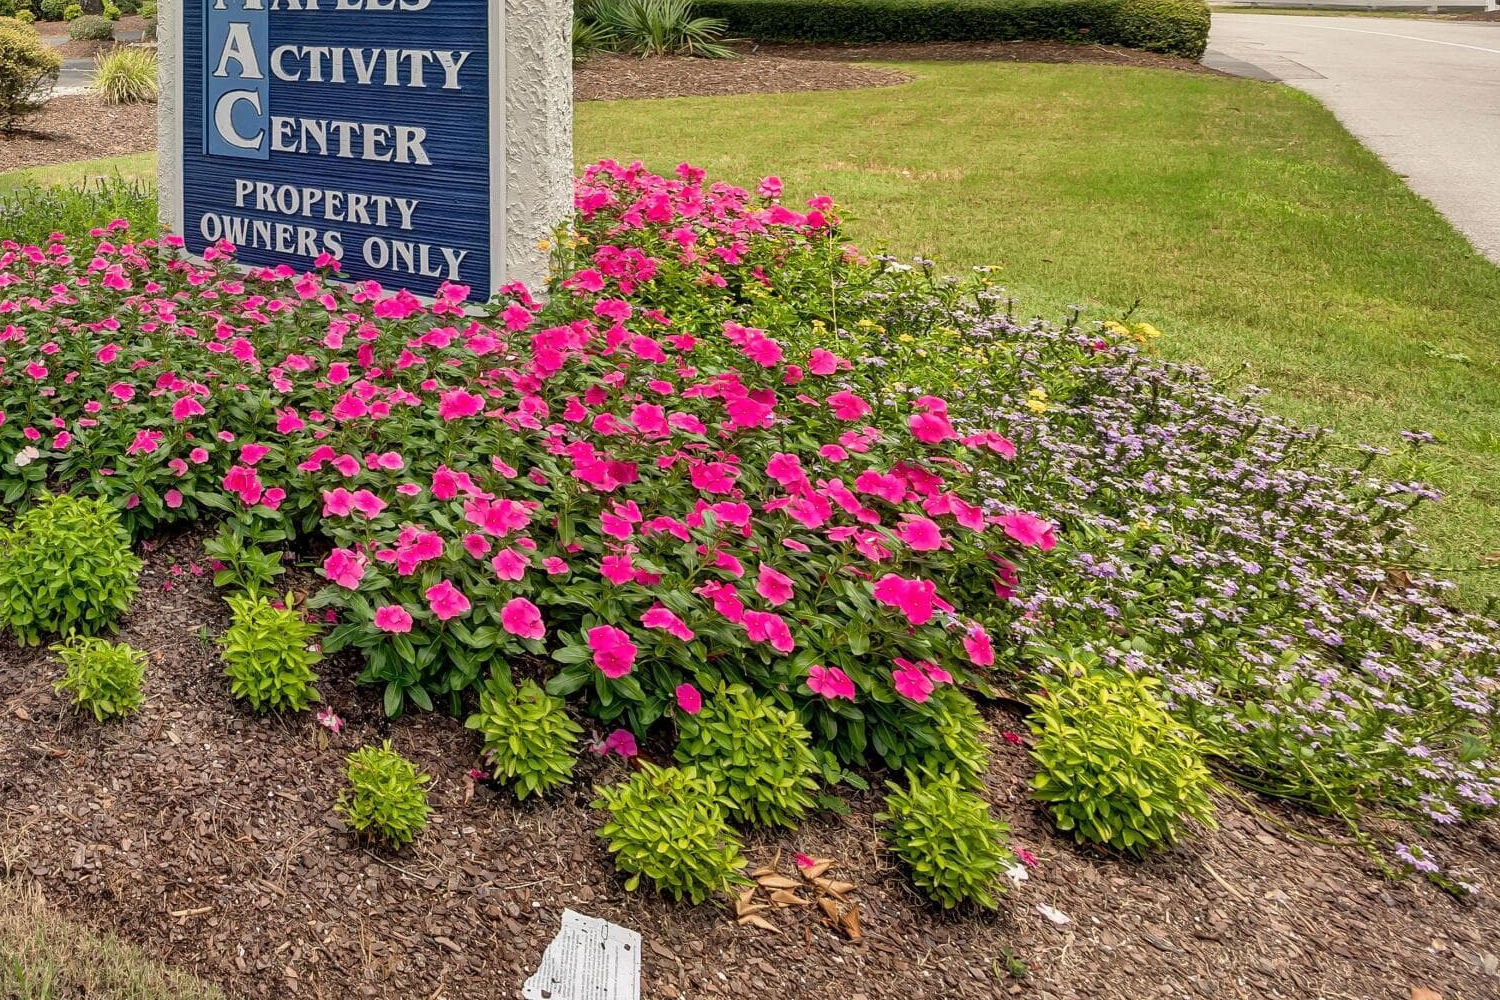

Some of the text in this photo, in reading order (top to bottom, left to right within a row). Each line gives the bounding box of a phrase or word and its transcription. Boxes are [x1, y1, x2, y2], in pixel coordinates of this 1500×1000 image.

[212, 22, 471, 90] ACTIVITY
[214, 88, 432, 166] CENTER
[235, 179, 419, 230] PROPERTY
[200, 212, 468, 281] OWNERS ONLY
